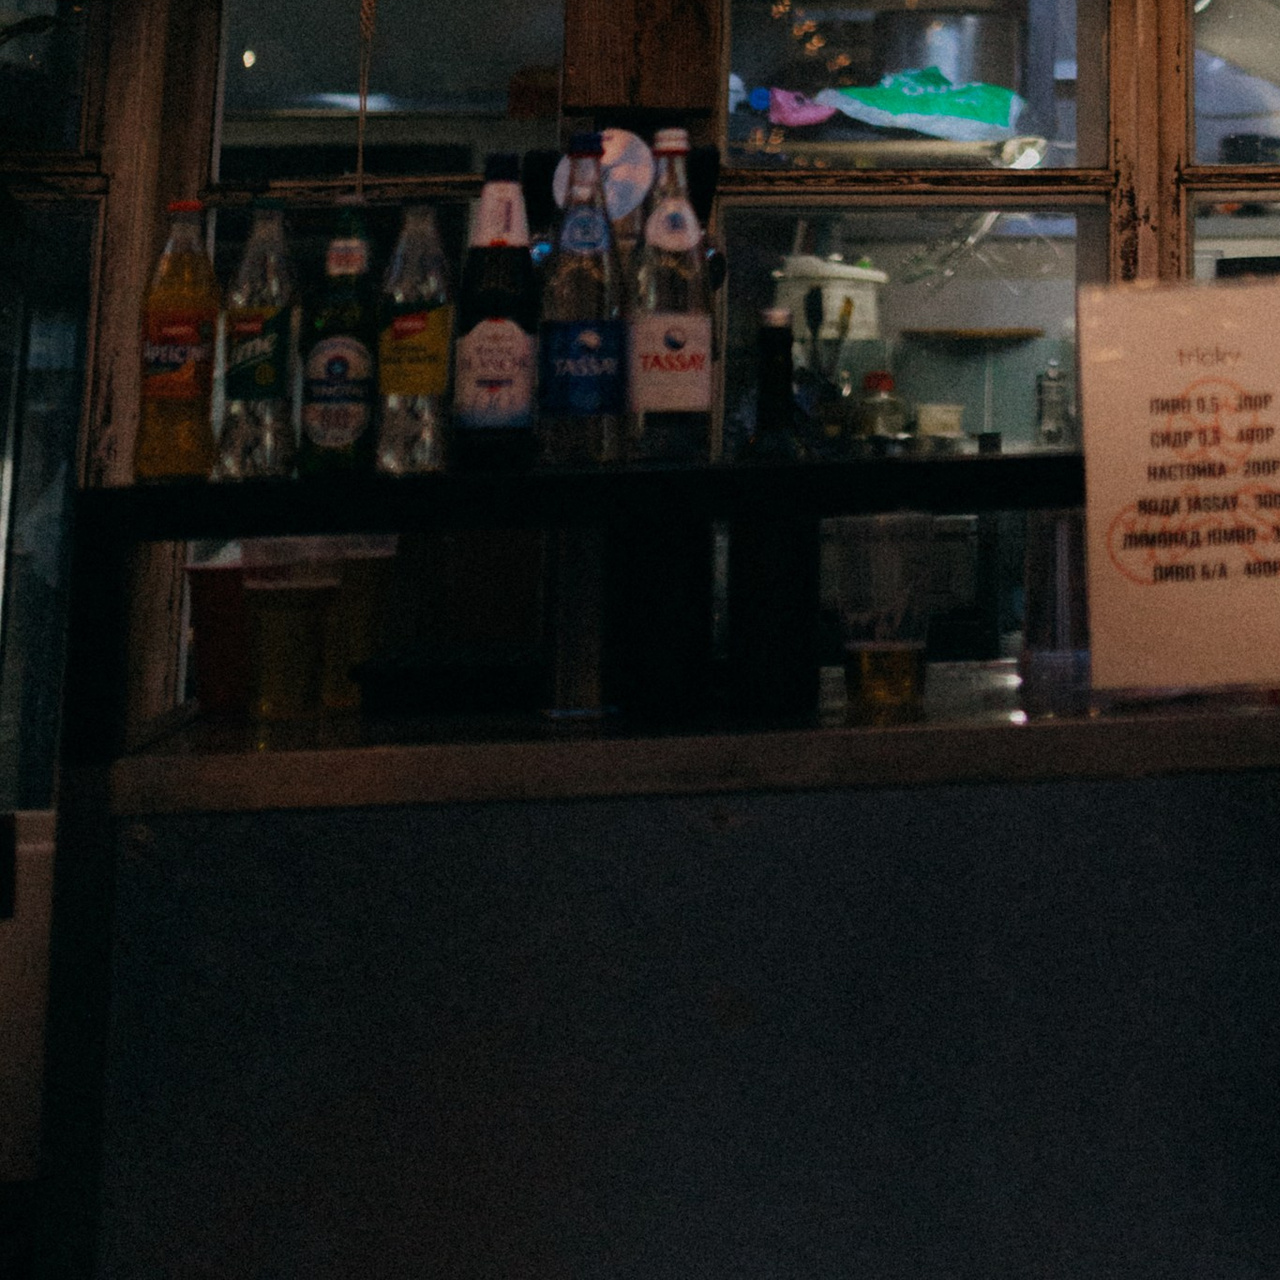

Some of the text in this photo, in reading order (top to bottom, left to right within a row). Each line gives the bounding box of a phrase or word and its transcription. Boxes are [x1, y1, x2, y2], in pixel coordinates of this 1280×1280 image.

[641, 354, 706, 372] TASSAY
[1150, 430, 1192, 449] СИДР
[1138, 497, 1180, 517] ВОДА
[1153, 564, 1195, 582] ПИВО
